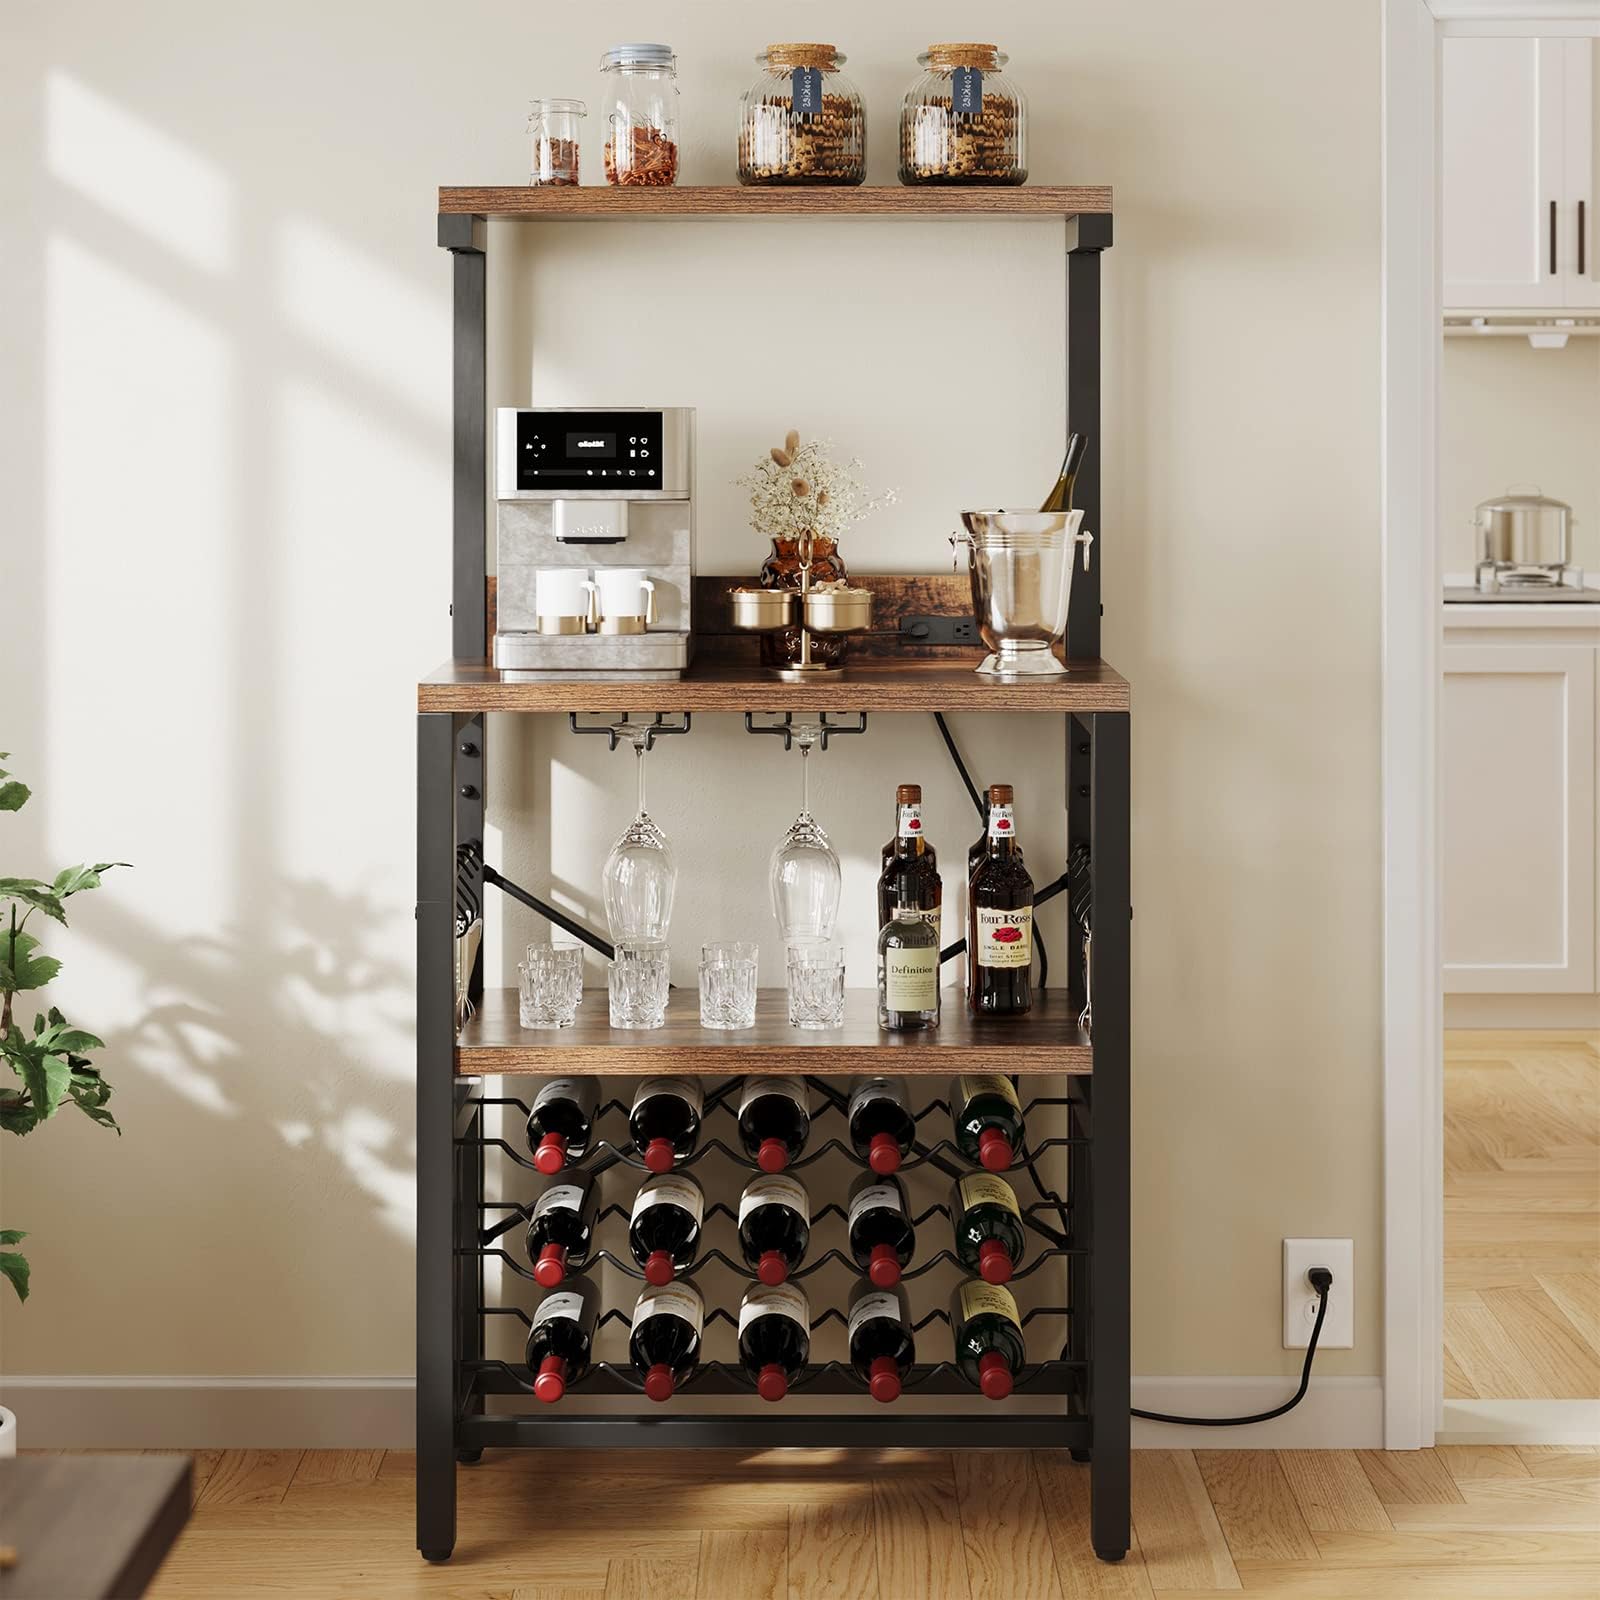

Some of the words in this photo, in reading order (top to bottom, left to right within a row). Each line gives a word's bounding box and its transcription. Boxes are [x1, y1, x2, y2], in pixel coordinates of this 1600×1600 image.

[981, 913, 1003, 924] Four
[1004, 913, 1032, 924] Roses
[891, 964, 933, 974] Definition
